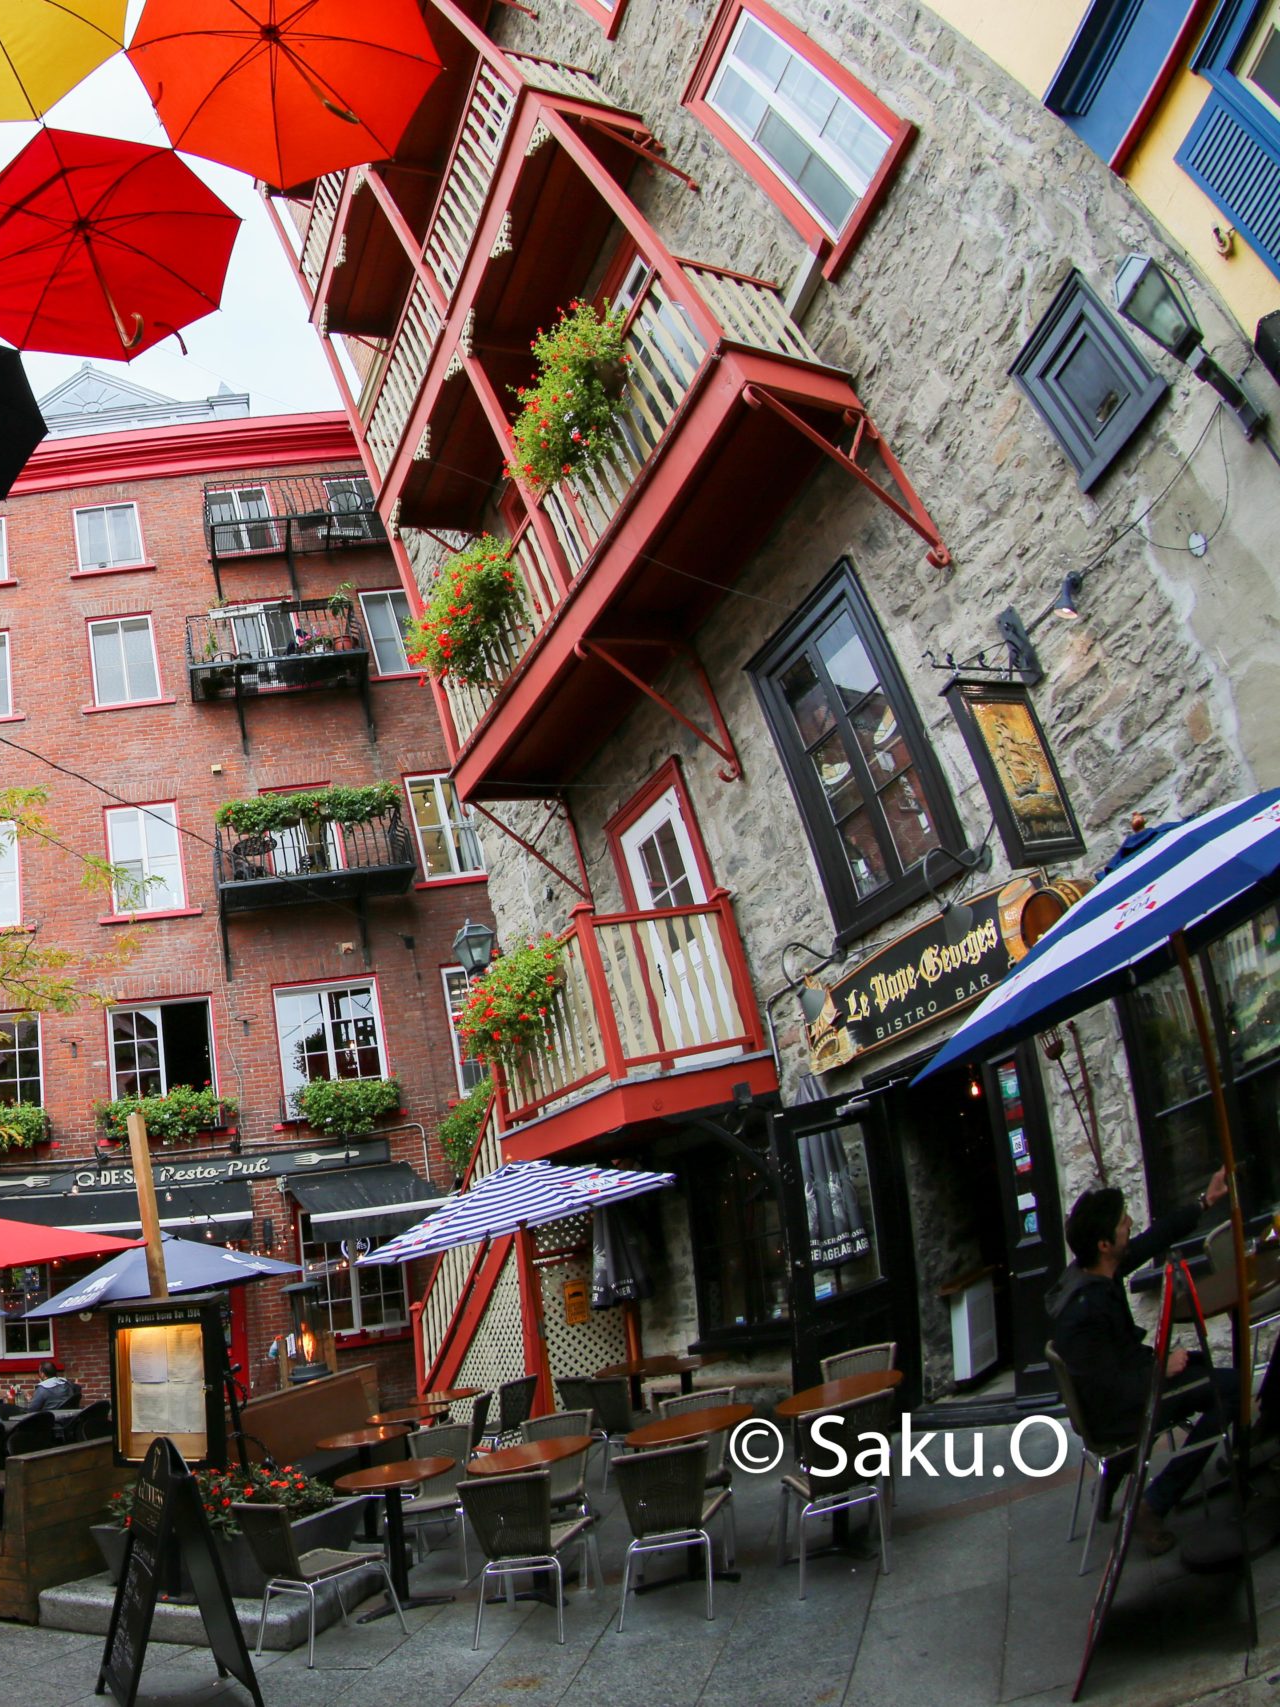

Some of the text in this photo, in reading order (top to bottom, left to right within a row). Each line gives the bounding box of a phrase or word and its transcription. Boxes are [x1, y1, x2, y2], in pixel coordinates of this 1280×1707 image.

[844, 989, 870, 1023] Le
[876, 973, 991, 1039] BISTRO BAR
[76, 1157, 270, 1187] Q-DE-S Resto-Pub
